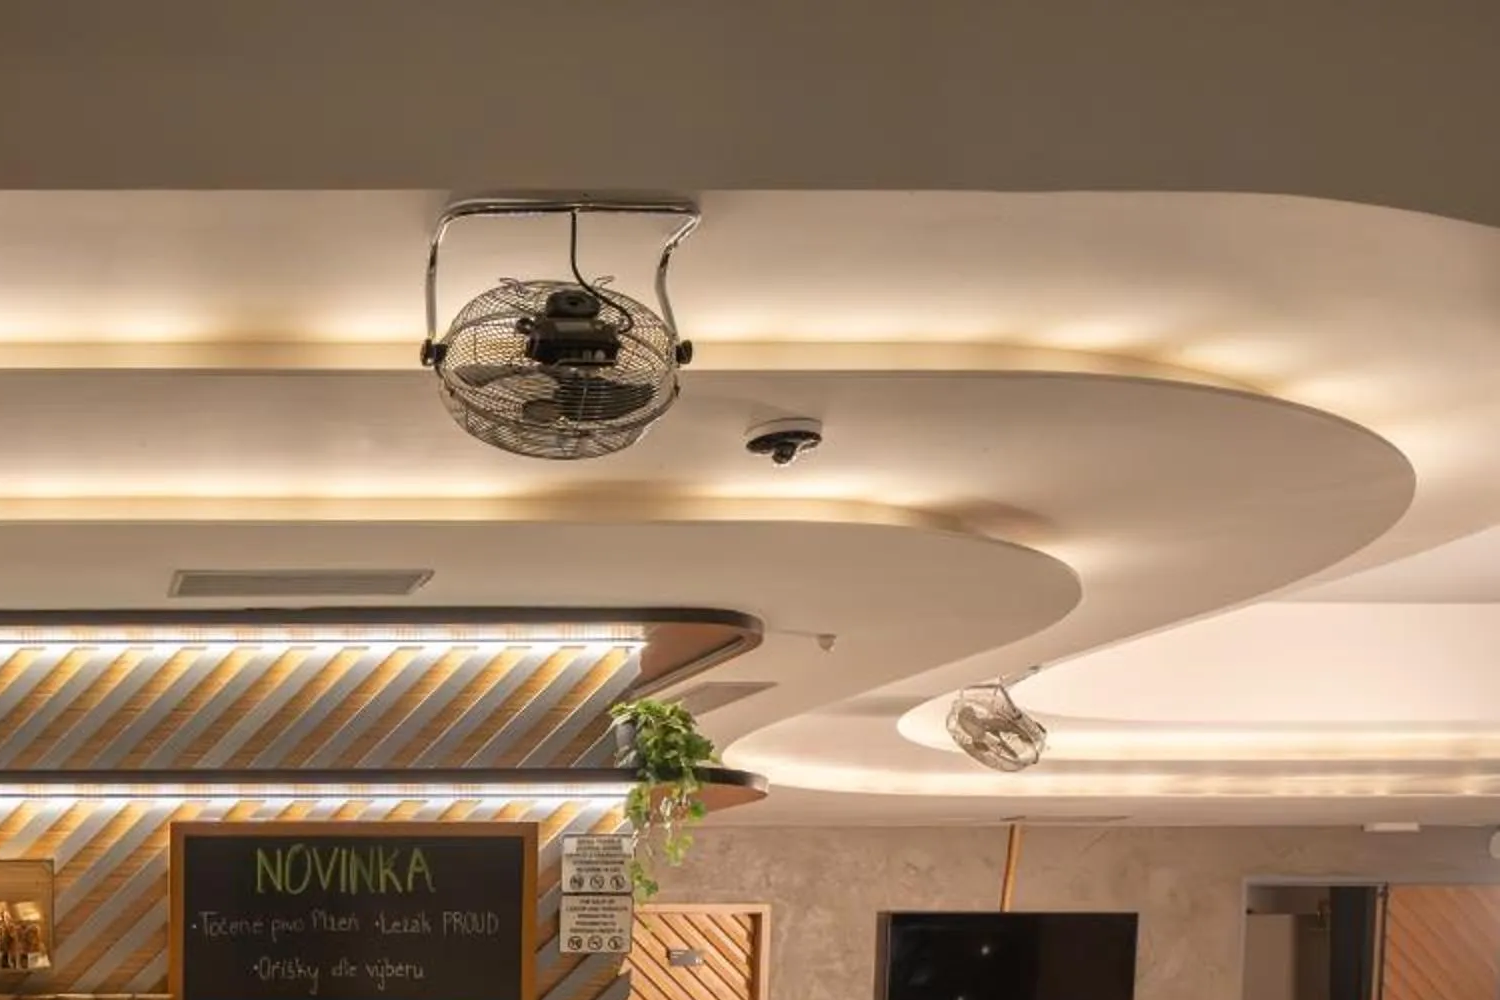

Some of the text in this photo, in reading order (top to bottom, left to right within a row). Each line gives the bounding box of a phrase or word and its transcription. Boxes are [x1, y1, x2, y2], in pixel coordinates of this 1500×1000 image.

[257, 843, 436, 895] NOVINKA
[442, 909, 500, 936] PROUD
[331, 956, 358, 977] dle
